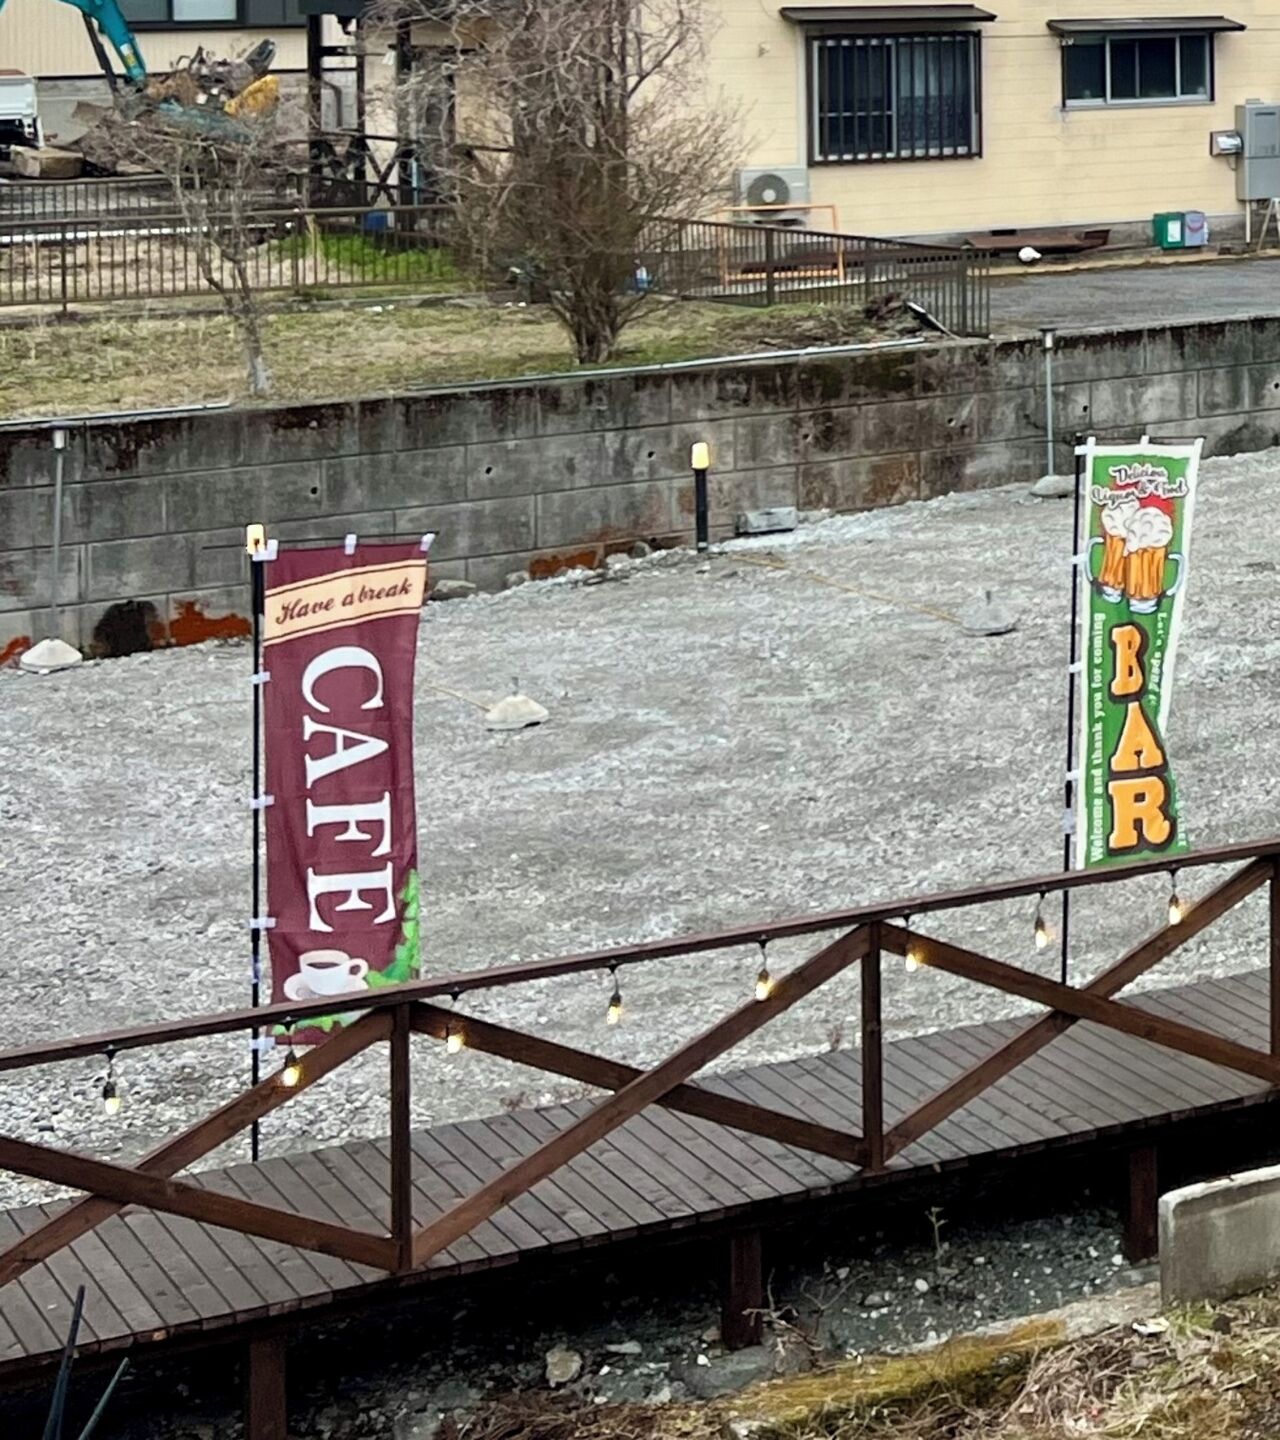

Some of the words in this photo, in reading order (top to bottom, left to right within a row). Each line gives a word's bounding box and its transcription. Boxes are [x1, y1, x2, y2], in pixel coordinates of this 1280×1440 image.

[275, 597, 334, 625] Have
[341, 592, 355, 608] a
[357, 576, 413, 604] break
[1093, 612, 1107, 665] coming
[1091, 668, 1103, 689] for
[1093, 692, 1106, 719] you
[1091, 721, 1103, 765] thank
[1108, 623, 1173, 850] BAR
[301, 645, 397, 933] CAFE
[1090, 768, 1103, 794] and
[1090, 798, 1104, 863] Welcome
